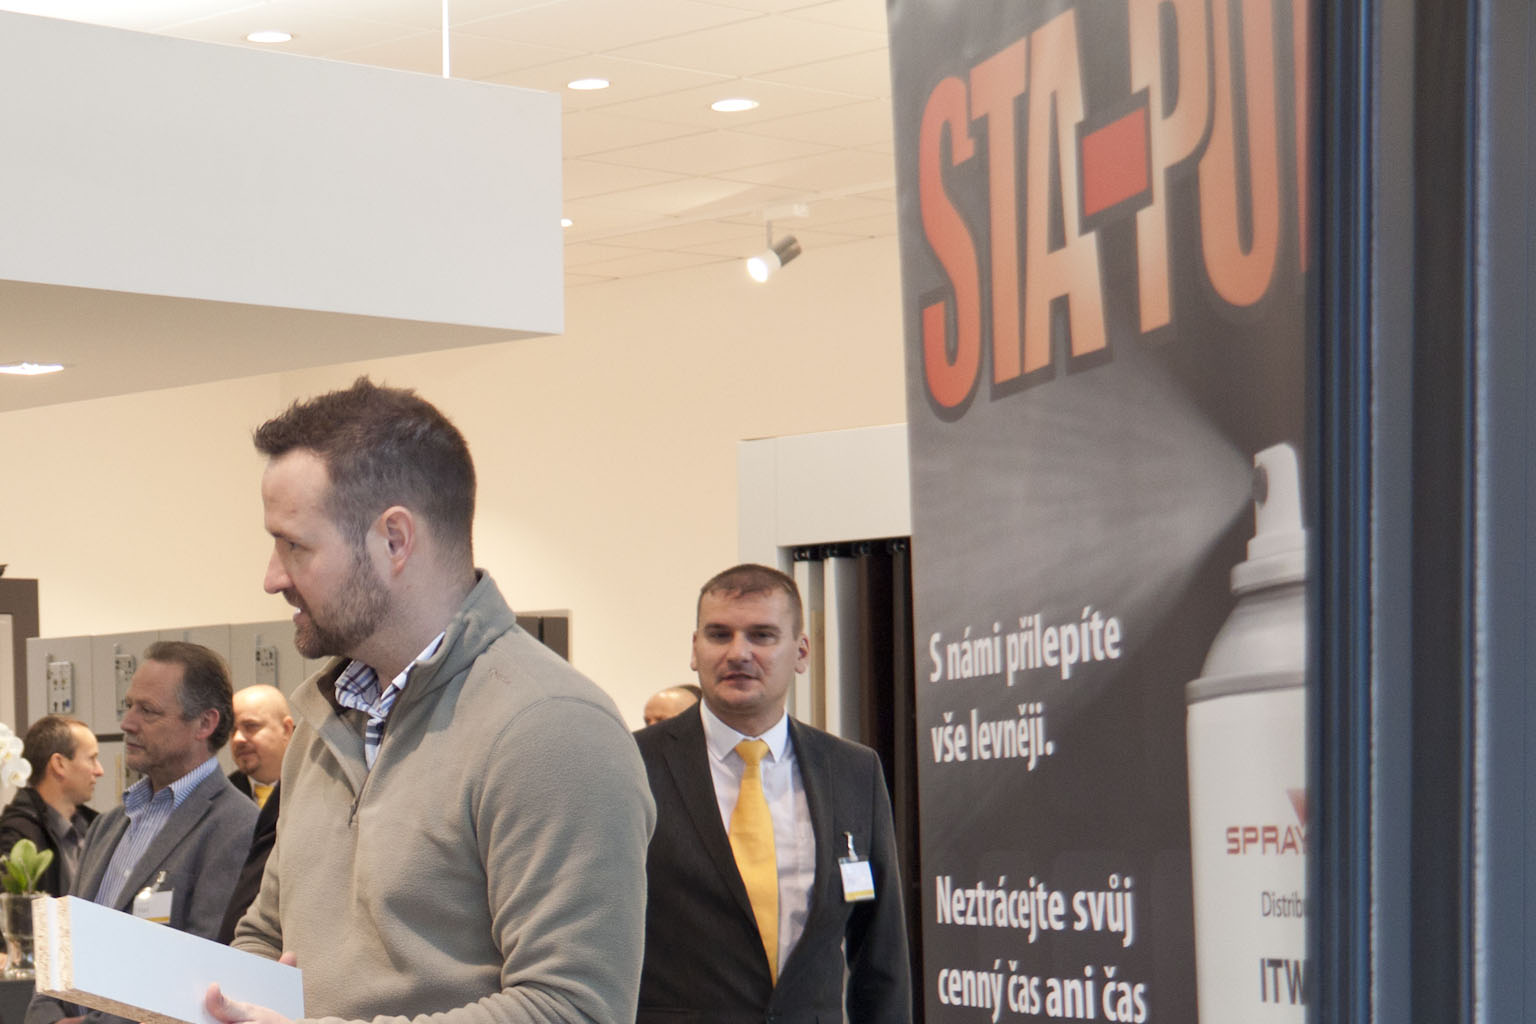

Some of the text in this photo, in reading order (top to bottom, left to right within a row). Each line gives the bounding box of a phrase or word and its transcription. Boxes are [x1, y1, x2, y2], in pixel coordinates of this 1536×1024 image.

[929, 607, 1122, 687] S námi přilepíte
[931, 703, 1055, 771] vše levněji.
[936, 873, 1135, 947] Neztrácejte svůj
[938, 959, 1148, 1024] cenný čas ani čas
